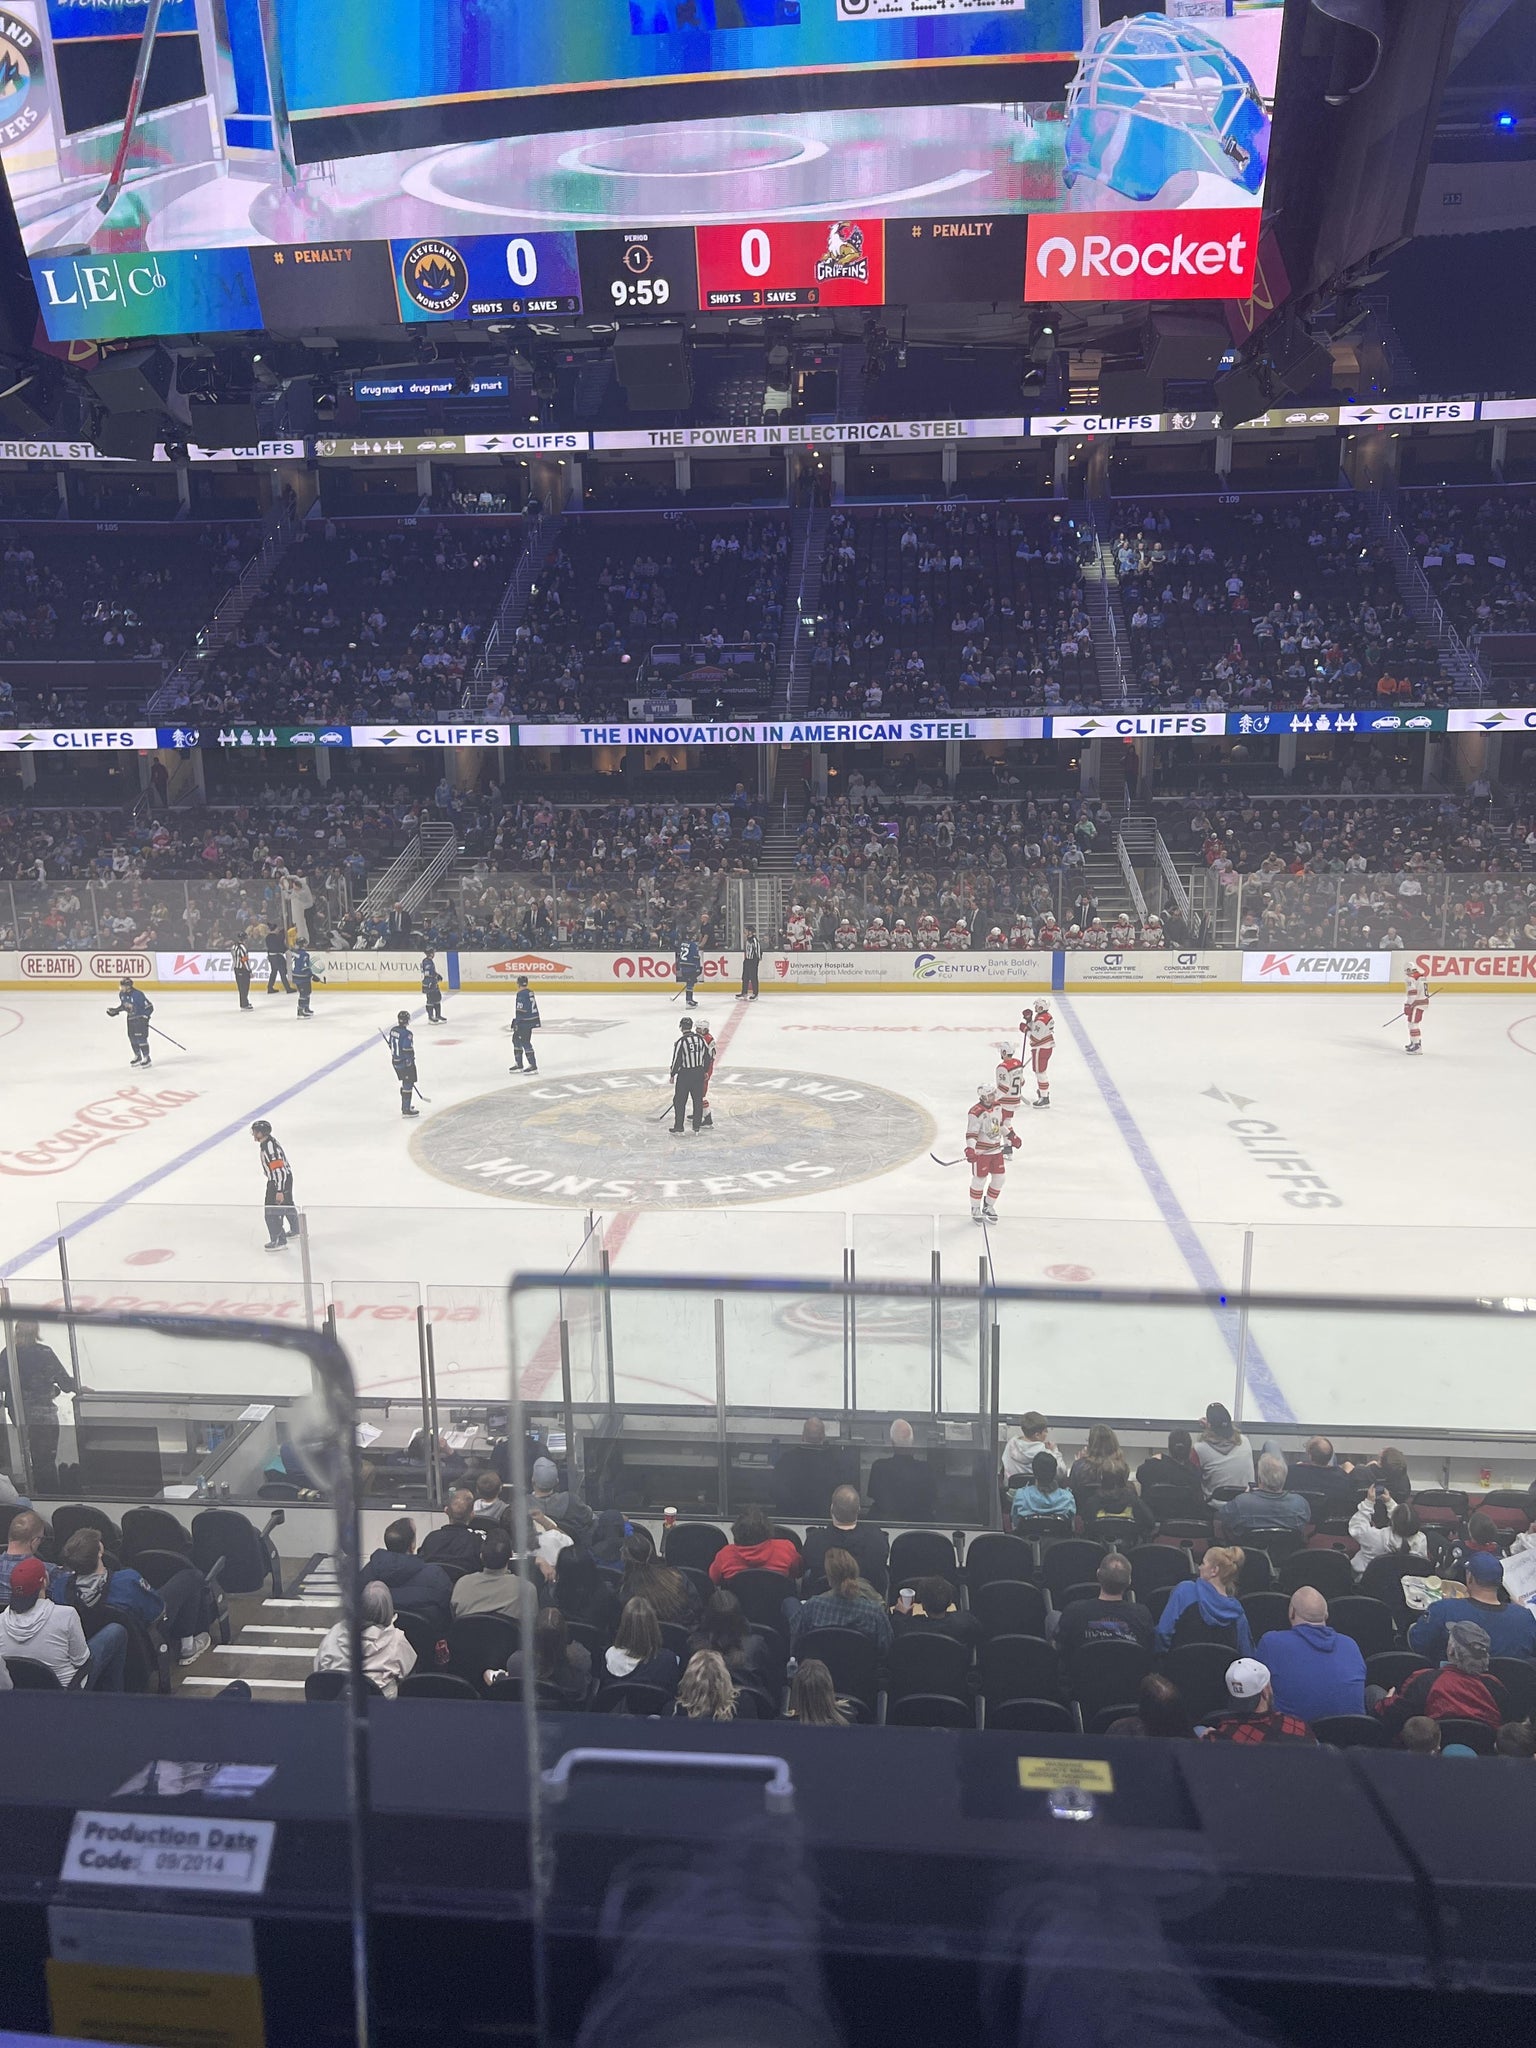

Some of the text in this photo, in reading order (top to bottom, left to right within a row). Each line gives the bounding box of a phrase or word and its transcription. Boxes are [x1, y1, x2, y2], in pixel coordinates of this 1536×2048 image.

[933, 222, 993, 238] PENALTY
[294, 248, 353, 263] PENALTY
[408, 243, 457, 265] CLEVELAND
[740, 228, 771, 277] 0
[1081, 231, 1247, 277] Rocket
[506, 238, 537, 286] 0
[817, 261, 868, 281] GRIFFINS
[415, 291, 460, 310] MONSTERS
[611, 279, 670, 306] 9:59
[710, 294, 741, 304] SHOTS
[753, 292, 760, 303] 3
[767, 292, 797, 302] SAVES
[472, 303, 503, 314] SHOTS
[512, 302, 520, 312] 6
[527, 301, 558, 311] SAVES
[360, 384, 403, 395] drug mart
[410, 383, 452, 395] drug mart
[481, 381, 503, 390] mart
[1388, 403, 1461, 420] CLIFFS
[1083, 415, 1153, 431] CLIFFS
[512, 435, 576, 448] CLIFFS
[648, 422, 968, 446] THE POWER IN ELECTRICAL STEEL
[232, 443, 294, 456] CLIFFS
[580, 721, 977, 744] THE INNOVATION IN AMERICAN STEEL
[1115, 717, 1207, 735] CLIFFS
[53, 731, 134, 748] CLIFFS
[416, 729, 500, 745] CLIFFS
[204, 958, 269, 972] KEDA
[328, 960, 421, 972] MEDICAL MUTUA
[505, 962, 555, 971] SERVPRO
[638, 956, 728, 978] Roet
[824, 962, 854, 970] Hospitals
[937, 964, 987, 973] CENTURY
[988, 959, 1008, 967] Bank
[1296, 957, 1371, 973] KENDA
[988, 968, 1003, 976] Live
[1341, 972, 1370, 981] TIRES
[811, 1024, 922, 1032] Rocket
[689, 1042, 699, 1053] 97
[530, 1073, 865, 1103] CLEVLAND
[1227, 1119, 1343, 1209] CLIFFS
[463, 1158, 836, 1200] MONSTERS
[84, 1821, 257, 1849] Production Date
